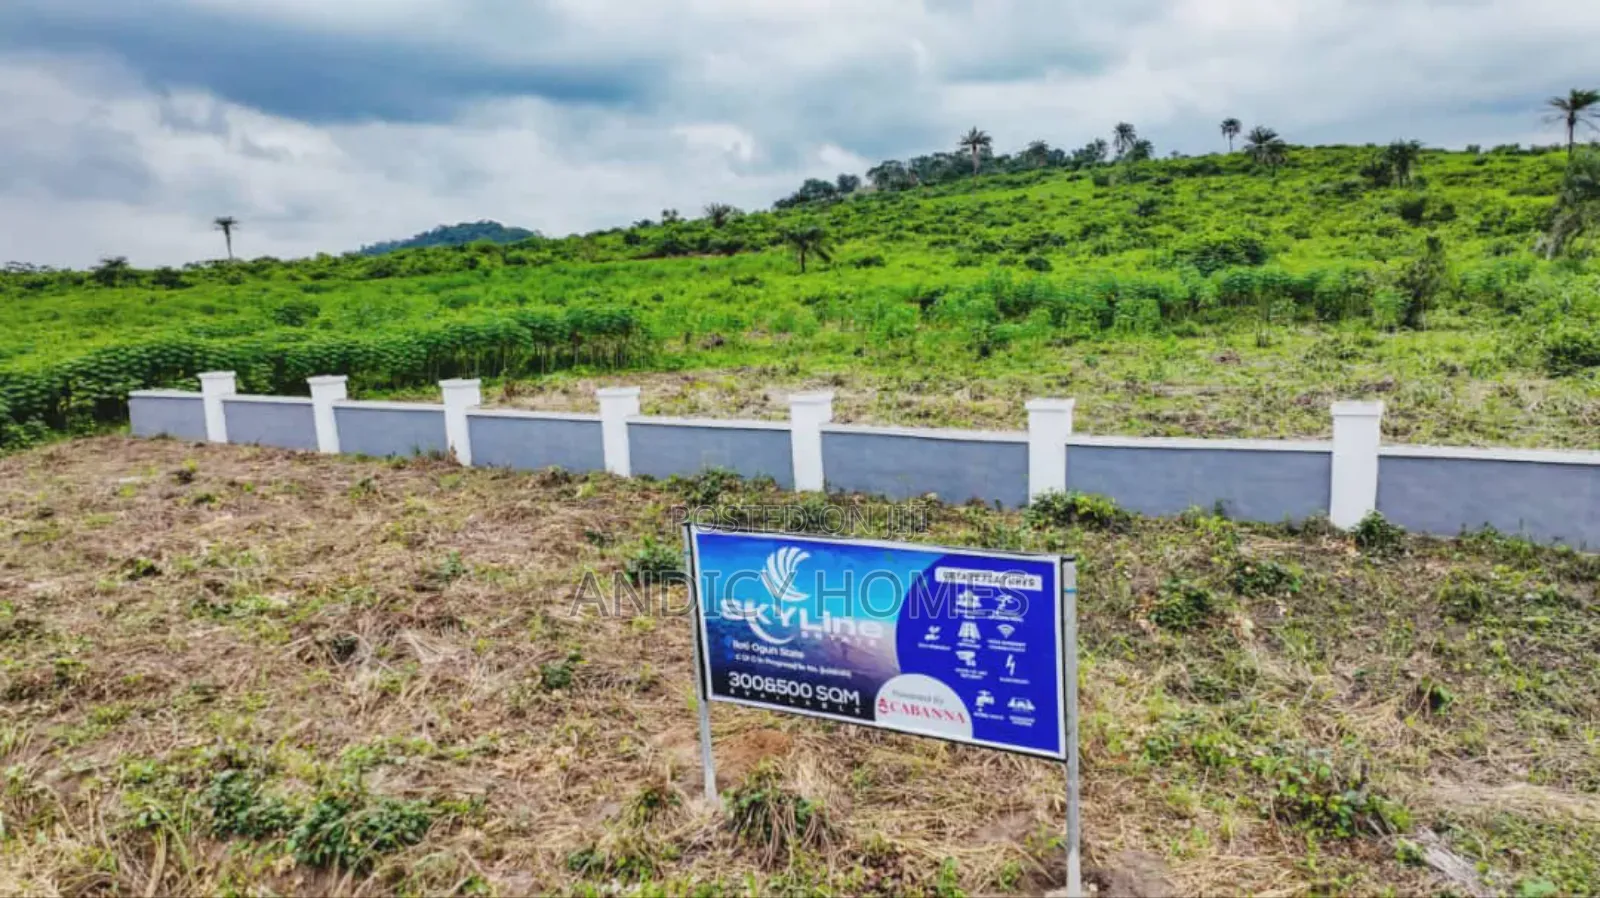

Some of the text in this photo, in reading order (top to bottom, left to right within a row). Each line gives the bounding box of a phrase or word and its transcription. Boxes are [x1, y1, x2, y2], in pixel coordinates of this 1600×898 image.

[728, 671, 860, 706] 300&500 SQM
[890, 701, 965, 724] CABANNA
